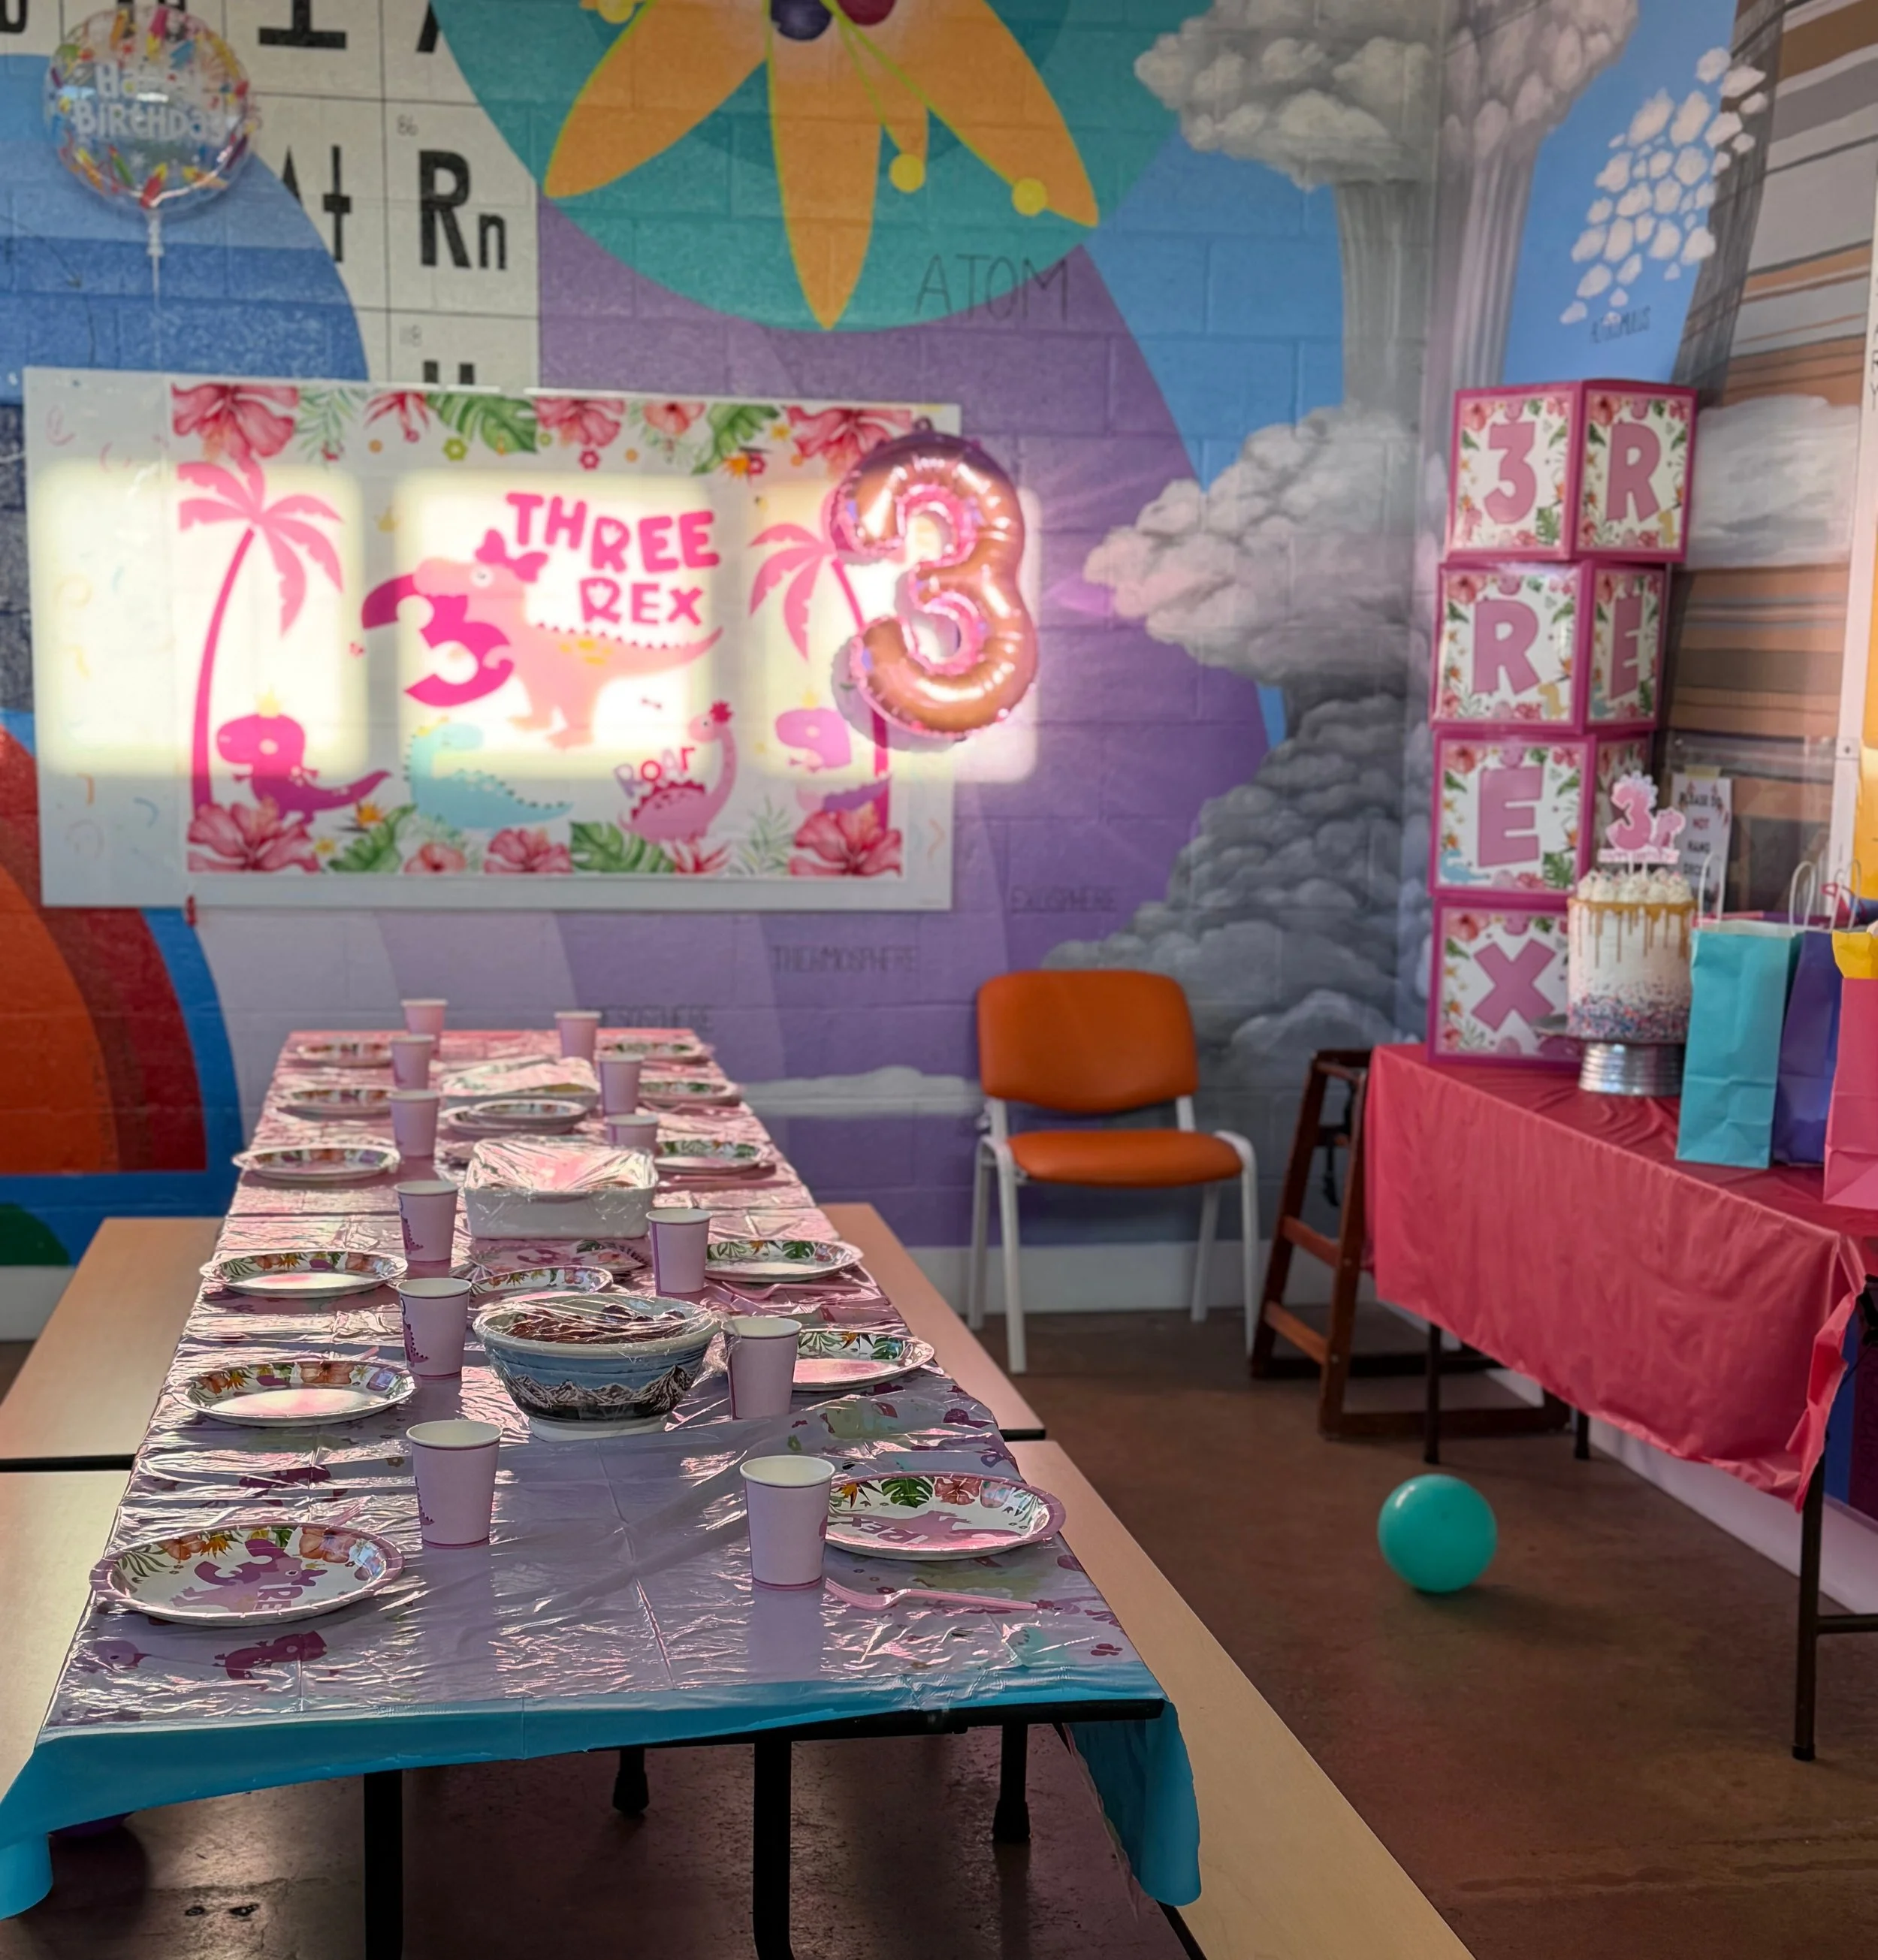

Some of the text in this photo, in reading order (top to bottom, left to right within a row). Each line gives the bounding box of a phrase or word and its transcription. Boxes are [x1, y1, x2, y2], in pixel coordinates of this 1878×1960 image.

[419, 149, 508, 271] Rn
[913, 252, 1069, 322] ATOM
[506, 492, 720, 575] THREE
[578, 576, 704, 627] REX
[770, 944, 920, 974] THERMOSPHERE
